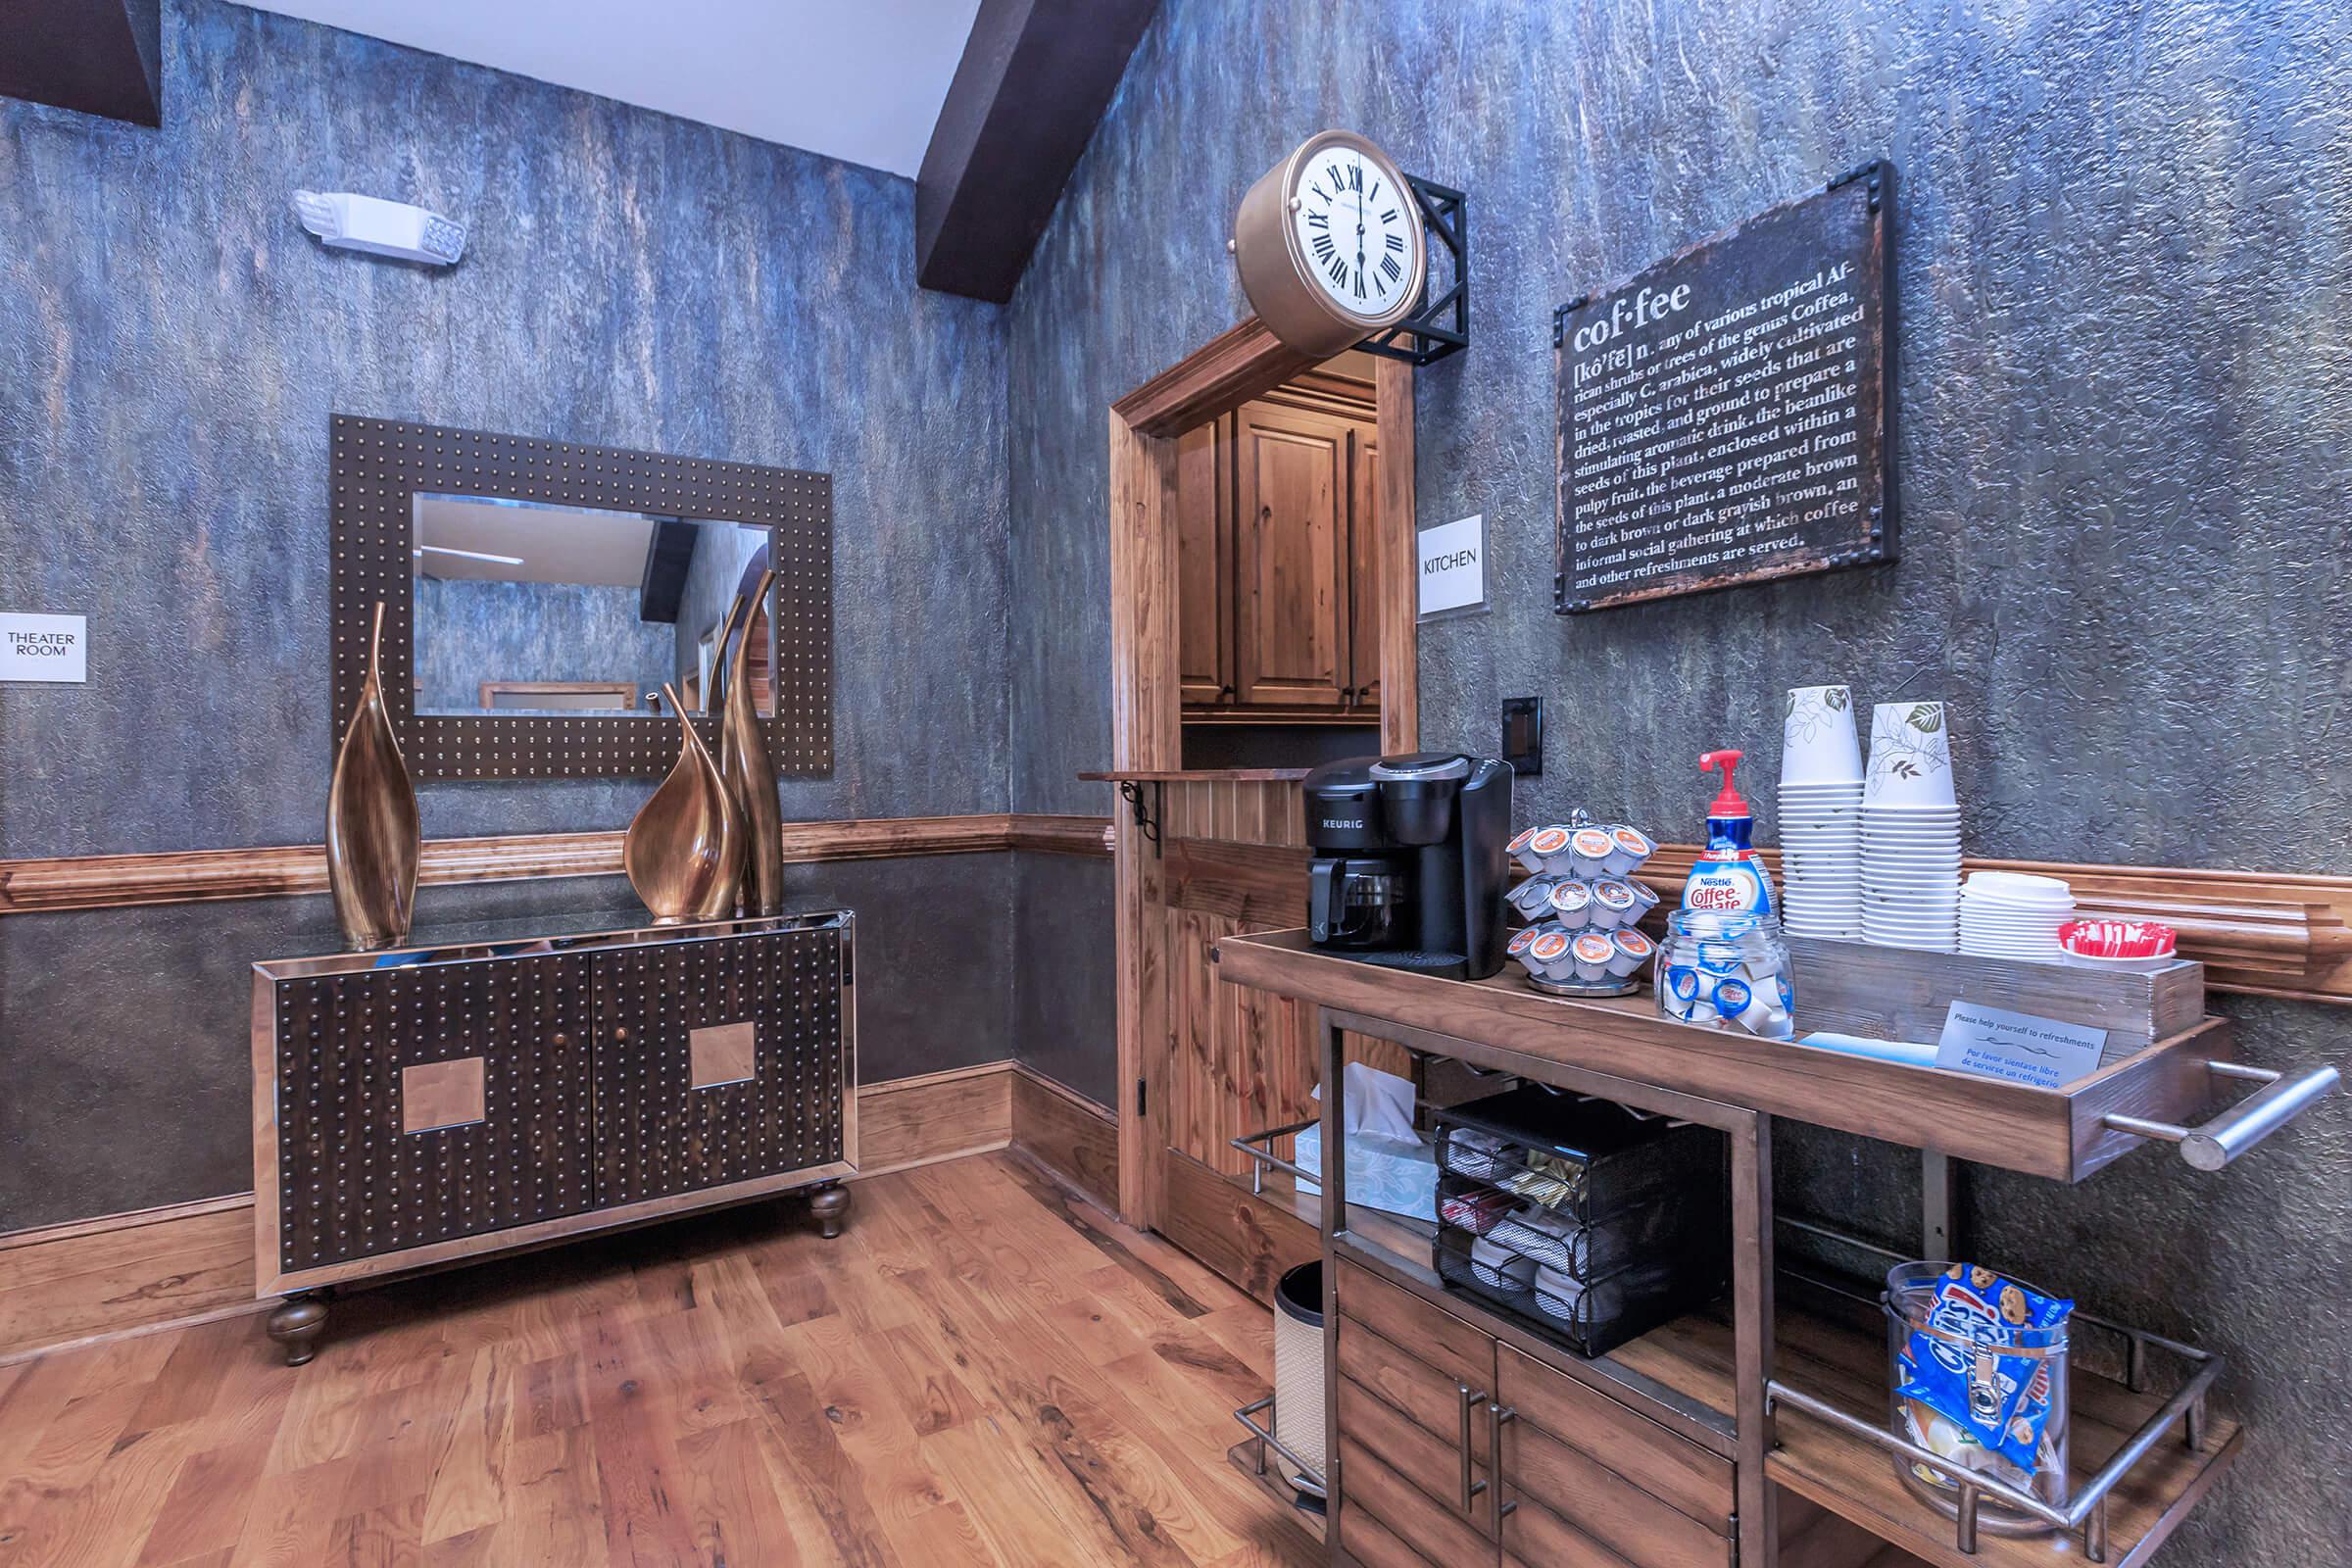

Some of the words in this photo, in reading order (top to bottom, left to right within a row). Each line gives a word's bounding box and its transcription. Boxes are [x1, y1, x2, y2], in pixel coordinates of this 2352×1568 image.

[1312, 181, 1332, 207] X
[1327, 165, 1346, 194] XI
[1308, 208, 1329, 229] IX
[1380, 209, 1397, 224] II
[1312, 233, 1336, 266] VIII
[1385, 233, 1403, 253] III
[1329, 256, 1348, 289] VII
[1373, 270, 1386, 297] V
[1636, 345, 1654, 360] n.
[1658, 331, 1683, 351] any
[1685, 319, 1702, 340] of
[1703, 302, 1757, 331] various
[1760, 271, 1823, 311] tropical
[1573, 390, 1637, 421] especially
[1639, 382, 1656, 398] C.
[1658, 364, 1717, 391] arabica,
[1720, 341, 1773, 368] widely
[1776, 304, 1864, 349] cultivated
[1574, 385, 1602, 404] rican
[1604, 368, 1644, 392] shrubs
[1646, 362, 1662, 375] or
[1664, 349, 1695, 368] trees
[1698, 337, 1715, 357] of
[1717, 333, 1740, 350] the
[1742, 314, 1788, 345] genus
[1790, 291, 1854, 321] Coffea,
[1574, 426, 1587, 441] in
[1590, 419, 1611, 435] the
[1614, 403, 1662, 426] tropics
[1666, 393, 1690, 411] for
[1693, 376, 1731, 401] their
[1734, 360, 1782, 387] seeds
[1786, 348, 1821, 369] that
[1826, 336, 1856, 356] are
[1574, 436, 1610, 459] dried,
[1666, 408, 1693, 429] and
[1695, 389, 1750, 425] ground
[1754, 388, 1770, 402] to
[1774, 365, 1840, 401] prepare
[1844, 359, 1855, 372] a
[1574, 449, 1642, 478] stimulating
[1643, 427, 1704, 458] aromatic
[1707, 414, 1754, 438] drink.
[1755, 406, 1781, 423] the
[1785, 383, 1856, 415] beanlike
[1574, 475, 1610, 496] seeds
[1613, 468, 1629, 484] of
[1632, 462, 1657, 479] this
[1660, 451, 1704, 476] plant,
[1707, 424, 1780, 458] enclosed
[1784, 410, 1839, 435] within
[1844, 406, 1856, 418] a
[1575, 497, 1609, 519] pulpy
[1611, 486, 1644, 506] fruit.
[1645, 480, 1666, 496] the
[1670, 465, 1733, 490] beverage
[1737, 438, 1809, 476] prepared
[1813, 430, 1856, 452] from
[1575, 519, 1593, 533] the
[1595, 510, 1629, 529] seeds
[1631, 504, 1646, 519] of
[1648, 499, 1672, 515] this
[1674, 490, 1715, 514] plant.
[1716, 488, 1725, 499] a
[1729, 468, 1801, 496] moderate
[1805, 454, 1858, 476] brown
[1575, 541, 1587, 552] to
[1590, 531, 1618, 549] dark
[1620, 524, 1660, 541] brown
[1663, 518, 1679, 531] or
[1682, 508, 1714, 527] dark
[1717, 494, 1770, 523] grayish
[1836, 477, 1857, 491] an
[1575, 548, 1626, 570] informal
[1629, 539, 1665, 560] social
[1668, 527, 1734, 556] gathering
[1736, 523, 1750, 536] at
[1753, 513, 1798, 532] which
[1803, 500, 1858, 521] coffee
[1424, 549, 1476, 575] KITCHEN
[1575, 573, 1596, 589] and
[1598, 569, 1631, 584] other
[1633, 552, 1719, 578] refreshments
[1722, 547, 1745, 561] are
[1748, 532, 1804, 555] served.
[8, 632, 74, 644] THEATER
[17, 645, 66, 656] ROOM
[1323, 819, 1363, 829] KEURIG
[1954, 1013, 1977, 1024] Please
[1979, 1017, 1994, 1028] help
[1995, 1023, 2028, 1035] yourself
[2039, 1032, 2094, 1050] refreshments
[1967, 1049, 1981, 1057] Por
[2039, 1065, 2059, 1077] libre
